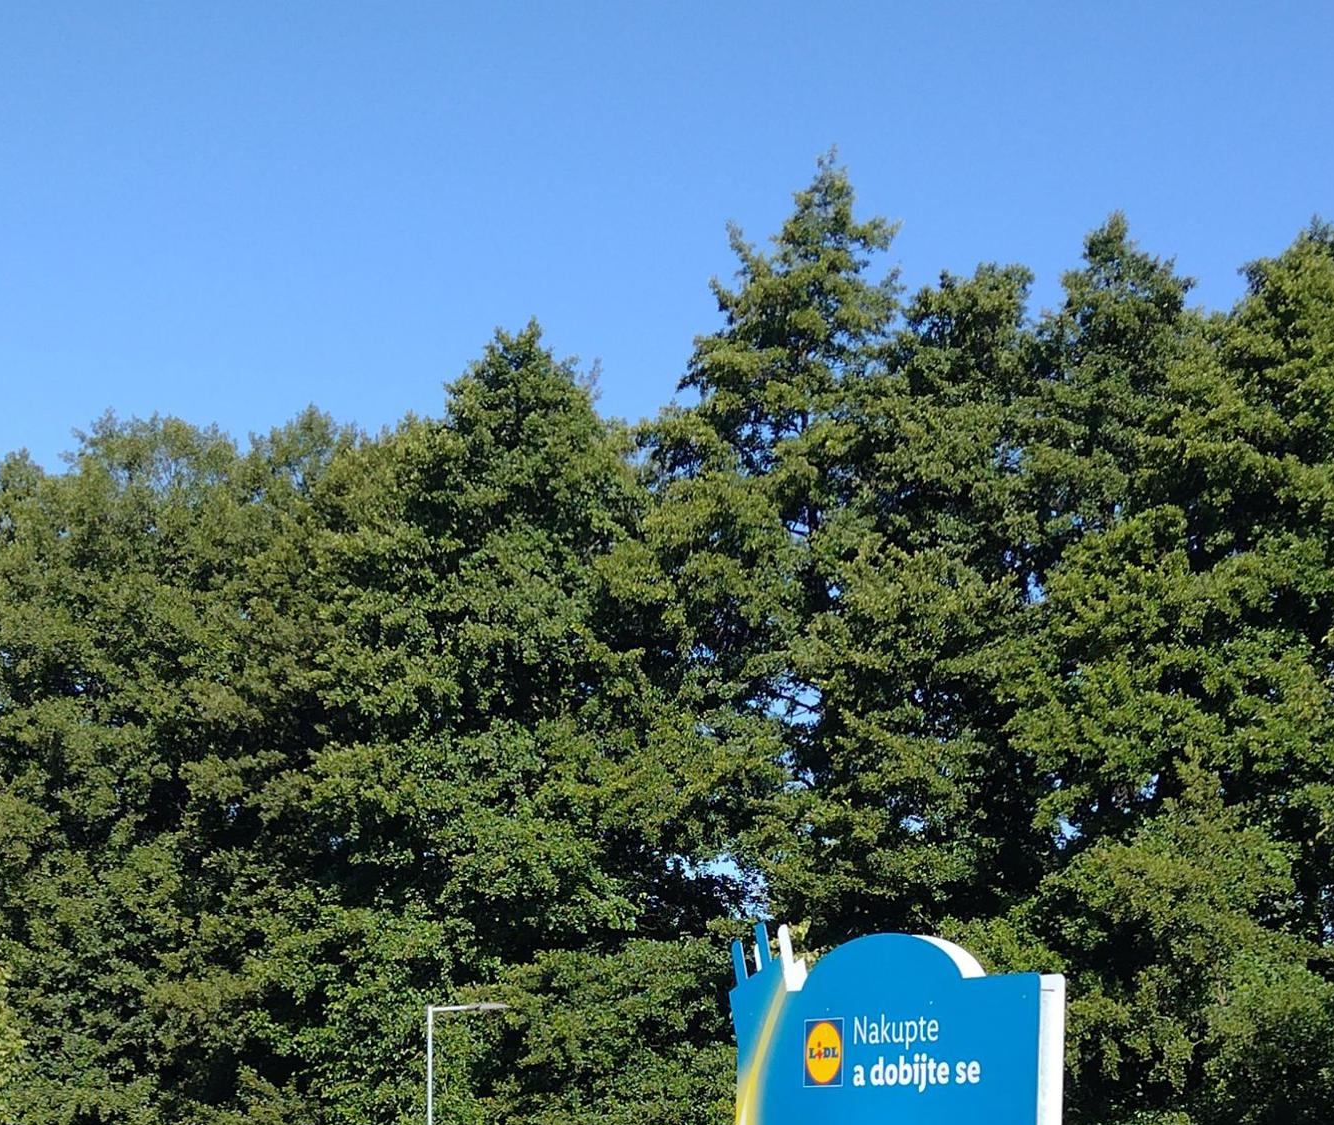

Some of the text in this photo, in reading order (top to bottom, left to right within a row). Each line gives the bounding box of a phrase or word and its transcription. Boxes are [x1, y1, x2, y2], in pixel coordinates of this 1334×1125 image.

[853, 1014, 939, 1050] Nakupte
[853, 1053, 981, 1092] a dobijte se
